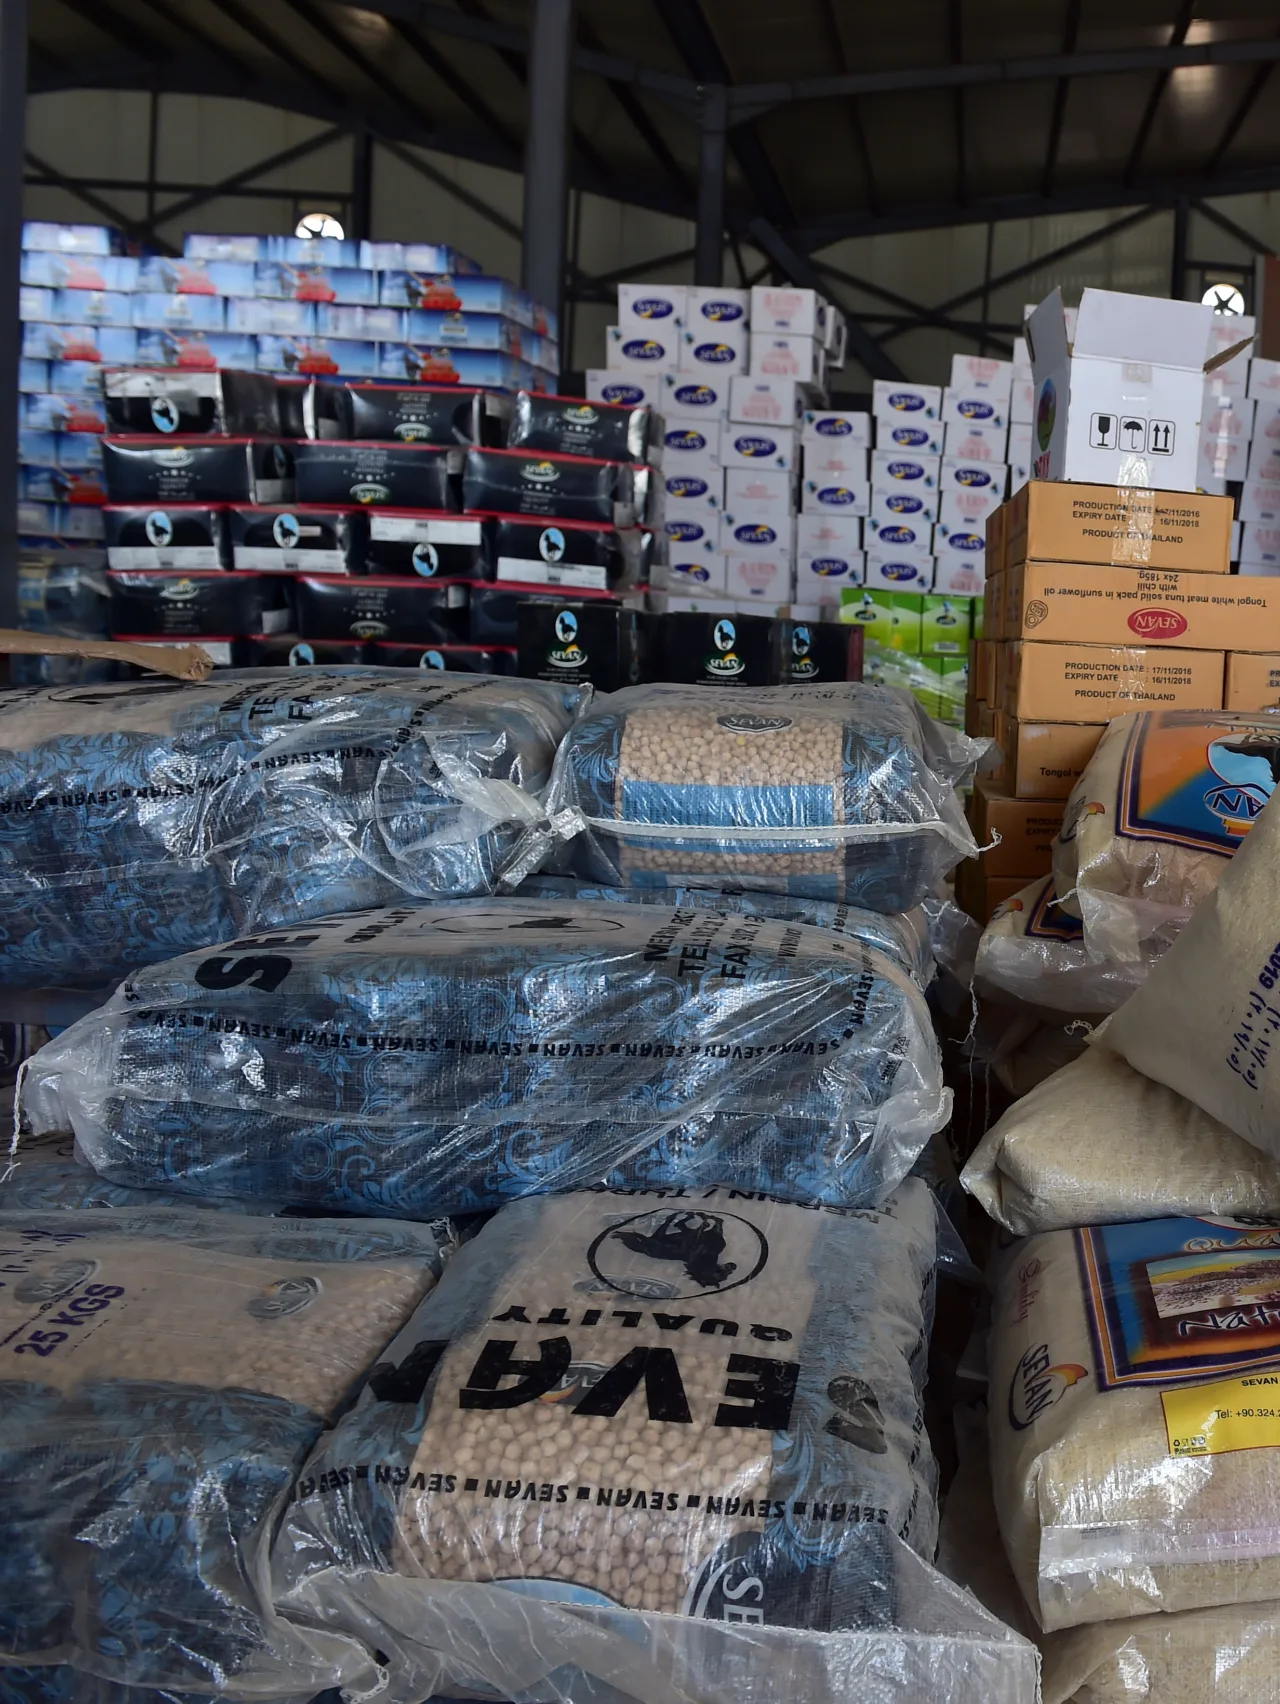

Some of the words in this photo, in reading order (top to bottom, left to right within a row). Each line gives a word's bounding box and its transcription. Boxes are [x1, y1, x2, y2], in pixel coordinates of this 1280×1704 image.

[1073, 500, 1128, 511] PRODUCTION
[1073, 511, 1103, 520] EXPIRY
[1104, 512, 1127, 522] DATE
[1160, 519, 1200, 528] 16/11/2018
[1082, 529, 1125, 539] PRODUCT
[1162, 574, 1180, 582] 24x
[1043, 587, 1056, 595] oil
[1058, 588, 1103, 598] sunflower
[1160, 583, 1179, 591] with
[1105, 590, 1115, 598] in
[1116, 591, 1139, 601] pack
[1140, 591, 1163, 602] solid
[1165, 593, 1186, 602] tuna
[1187, 594, 1209, 603] meat
[1212, 596, 1235, 605] white
[1238, 595, 1268, 608] Tongol
[1135, 615, 1178, 629] SEVAN
[1065, 662, 1120, 672] PRODUCTION
[1123, 664, 1144, 673] DATE
[1152, 667, 1192, 675] 17/11/2016
[1065, 672, 1095, 681] EXPIRY
[1097, 673, 1119, 681] DATE
[1075, 690, 1117, 699] PRODUCT
[1133, 692, 1175, 701] THAILAND
[724, 715, 782, 730] SEVAN
[265, 751, 320, 769] SEVAN
[1040, 767, 1071, 779] Tongol
[291, 1029, 351, 1049] SEVAN
[373, 1037, 439, 1053] SEVAN
[460, 1041, 522, 1056] SEVAN
[543, 1043, 605, 1057] SEVAN
[13, 1330, 68, 1357] 25
[48, 1283, 126, 1326] KGS
[492, 1305, 793, 1342] QUALITY
[1022, 1344, 1054, 1422] SEVAN
[1241, 1377, 1279, 1388] SEVAN
[1215, 1408, 1233, 1421] Tel:
[376, 1464, 457, 1495] SEVAN
[484, 1478, 568, 1503] SEVAN
[596, 1487, 679, 1511] SEVAN
[706, 1494, 785, 1519] SEVAN
[812, 1502, 890, 1525] SEVAN
